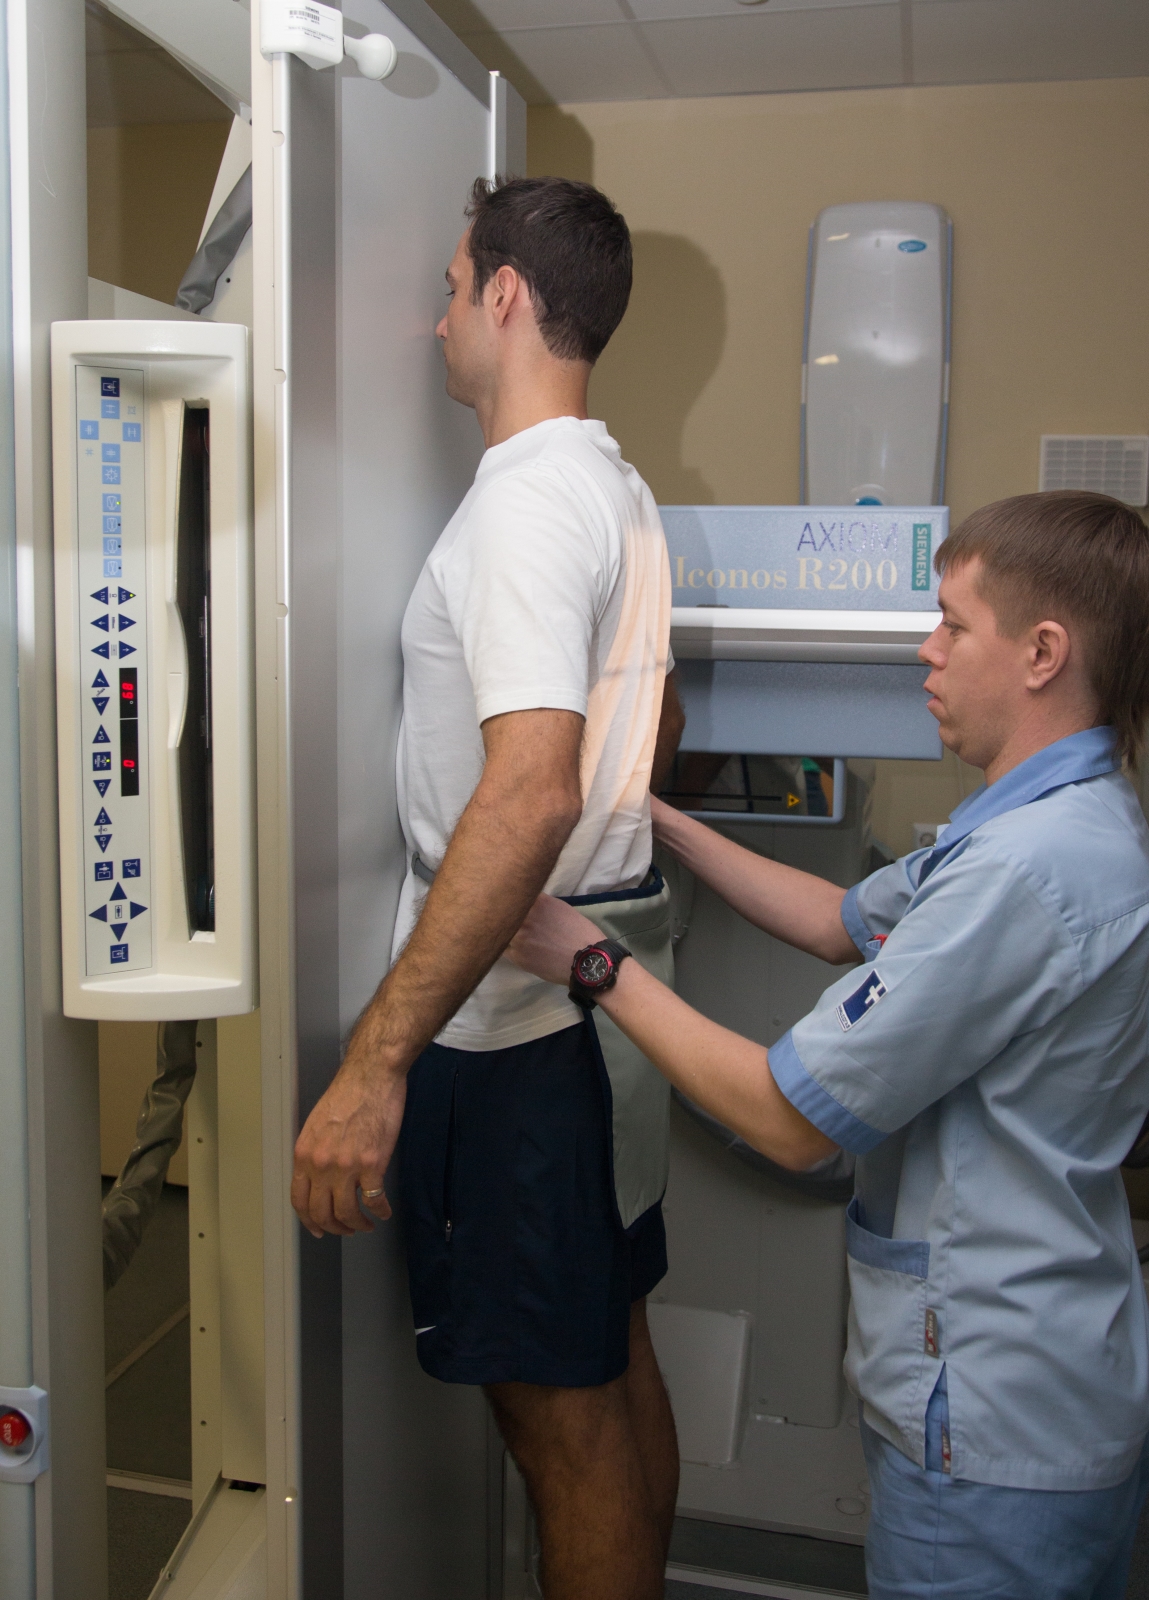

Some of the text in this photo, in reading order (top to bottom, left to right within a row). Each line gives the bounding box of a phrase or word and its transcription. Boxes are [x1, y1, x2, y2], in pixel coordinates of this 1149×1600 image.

[797, 521, 898, 552] AXIOM
[673, 556, 898, 591] Iconos R200
[915, 527, 928, 587] SIEMENS
[3, 1423, 12, 1445] STOP
